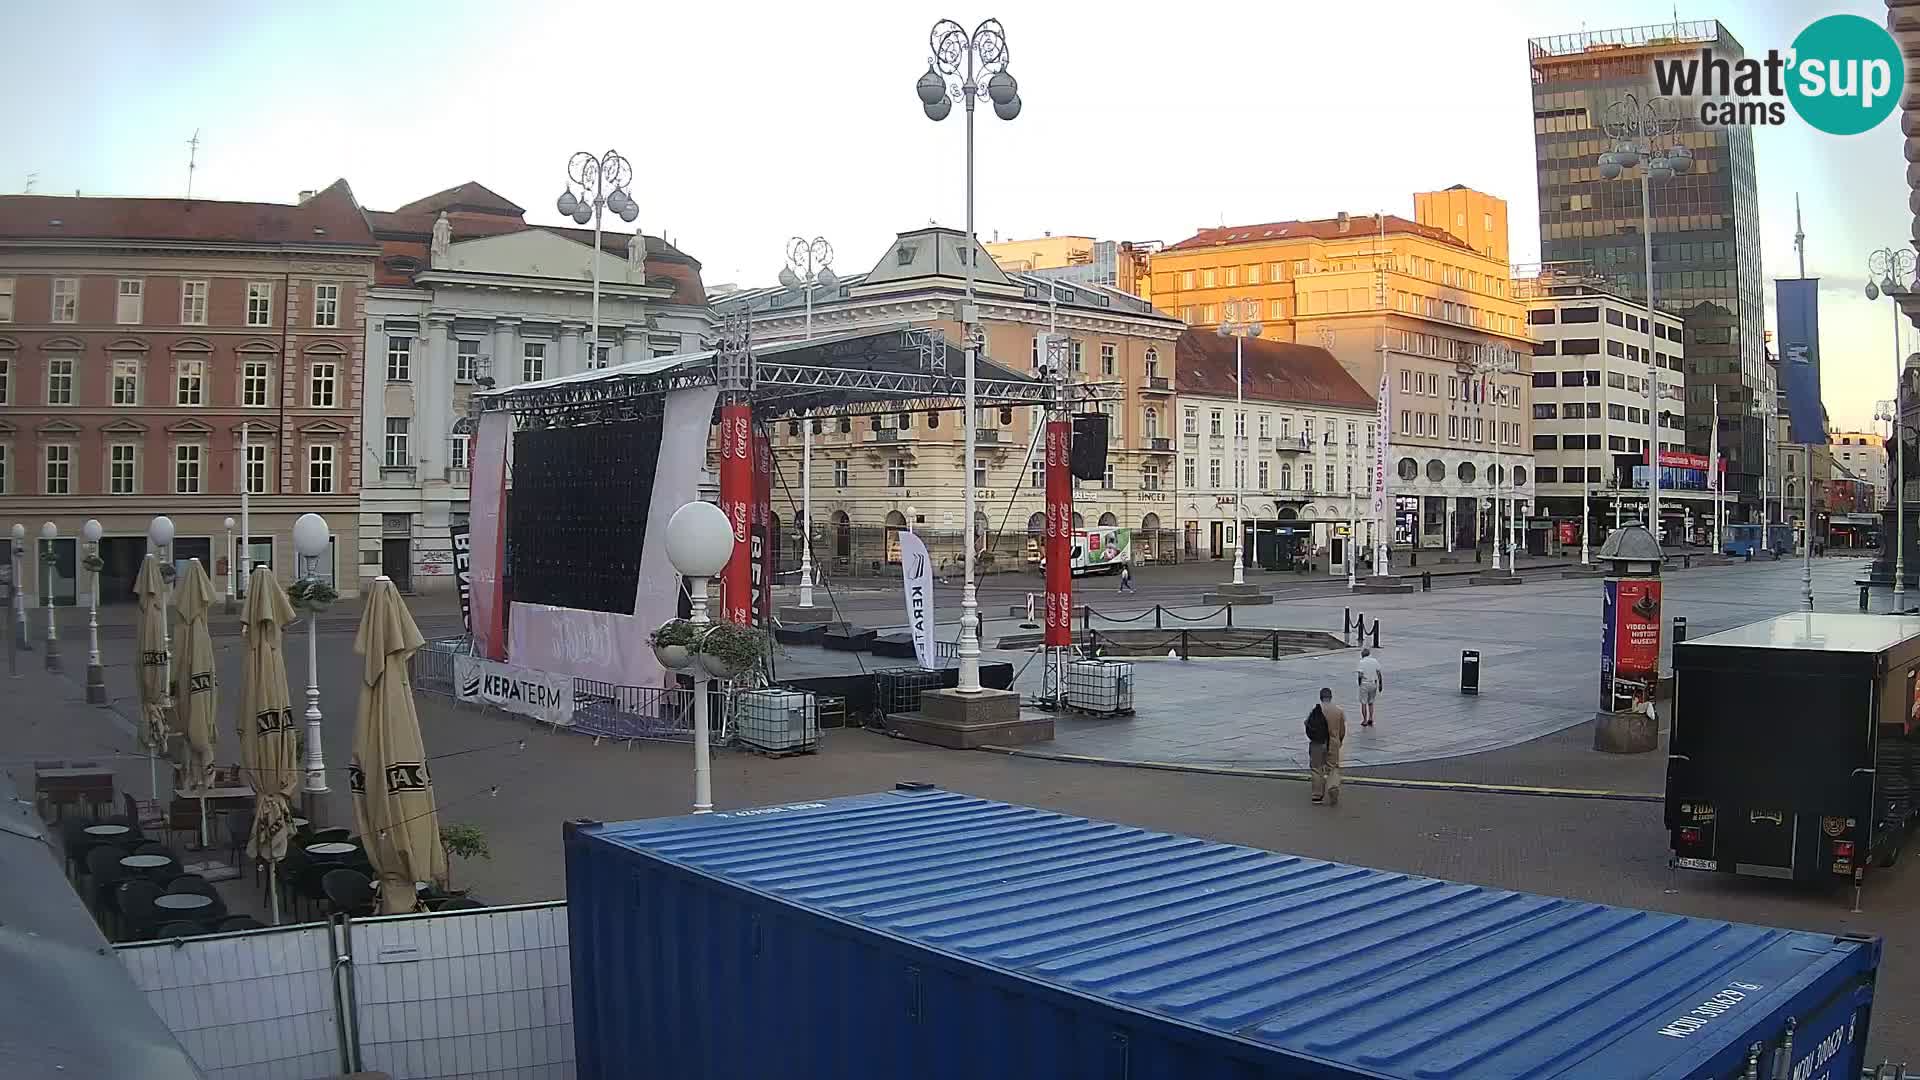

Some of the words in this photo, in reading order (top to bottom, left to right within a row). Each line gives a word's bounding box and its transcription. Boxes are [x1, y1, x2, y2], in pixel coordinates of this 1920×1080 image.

[1138, 493, 1166, 502] SINGER
[1625, 623, 1646, 631] VIDEO
[484, 674, 560, 711] KERATERM
[1657, 1015, 1708, 1038] MCDU
[1690, 989, 1747, 1018] 300629
